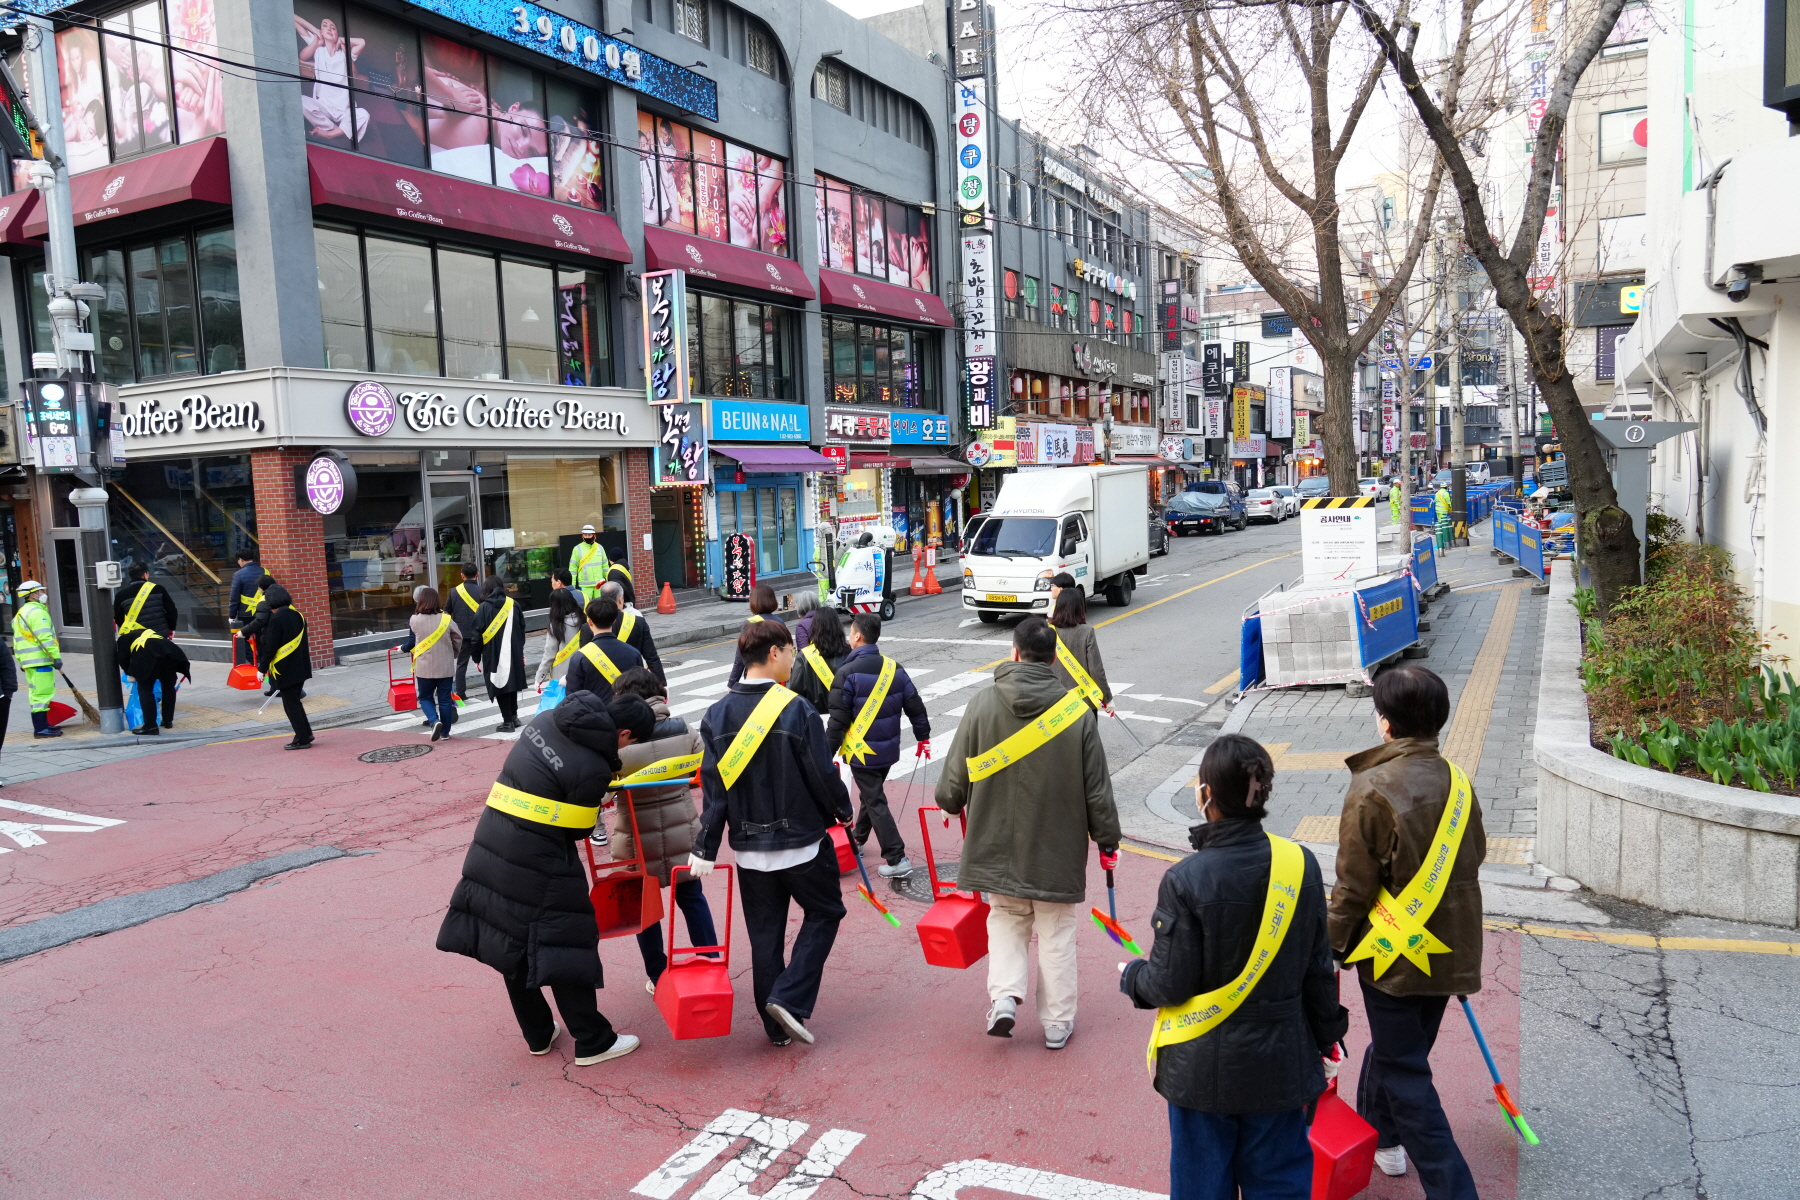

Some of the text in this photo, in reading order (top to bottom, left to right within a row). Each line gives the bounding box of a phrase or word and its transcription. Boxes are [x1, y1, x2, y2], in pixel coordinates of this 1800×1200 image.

[512, 5, 642, 81] 39000원
[960, 88, 980, 198] 현당구장
[396, 207, 443, 224] The Coffee Bean
[1206, 348, 1219, 388] 에쿠스
[970, 362, 990, 428] 왕과비
[122, 394, 262, 437] offee Bean
[396, 391, 630, 436] The Coffee Bean
[893, 417, 948, 441] 에이스 호프
[1298, 417, 1306, 445] 닭도리탕
[1319, 515, 1351, 523] 공사안내
[976, 757, 998, 772] 쓰레기
[1268, 901, 1285, 939] 쓰레기
[1370, 943, 1388, 959] 강북구
[1414, 939, 1430, 956] 강북구
